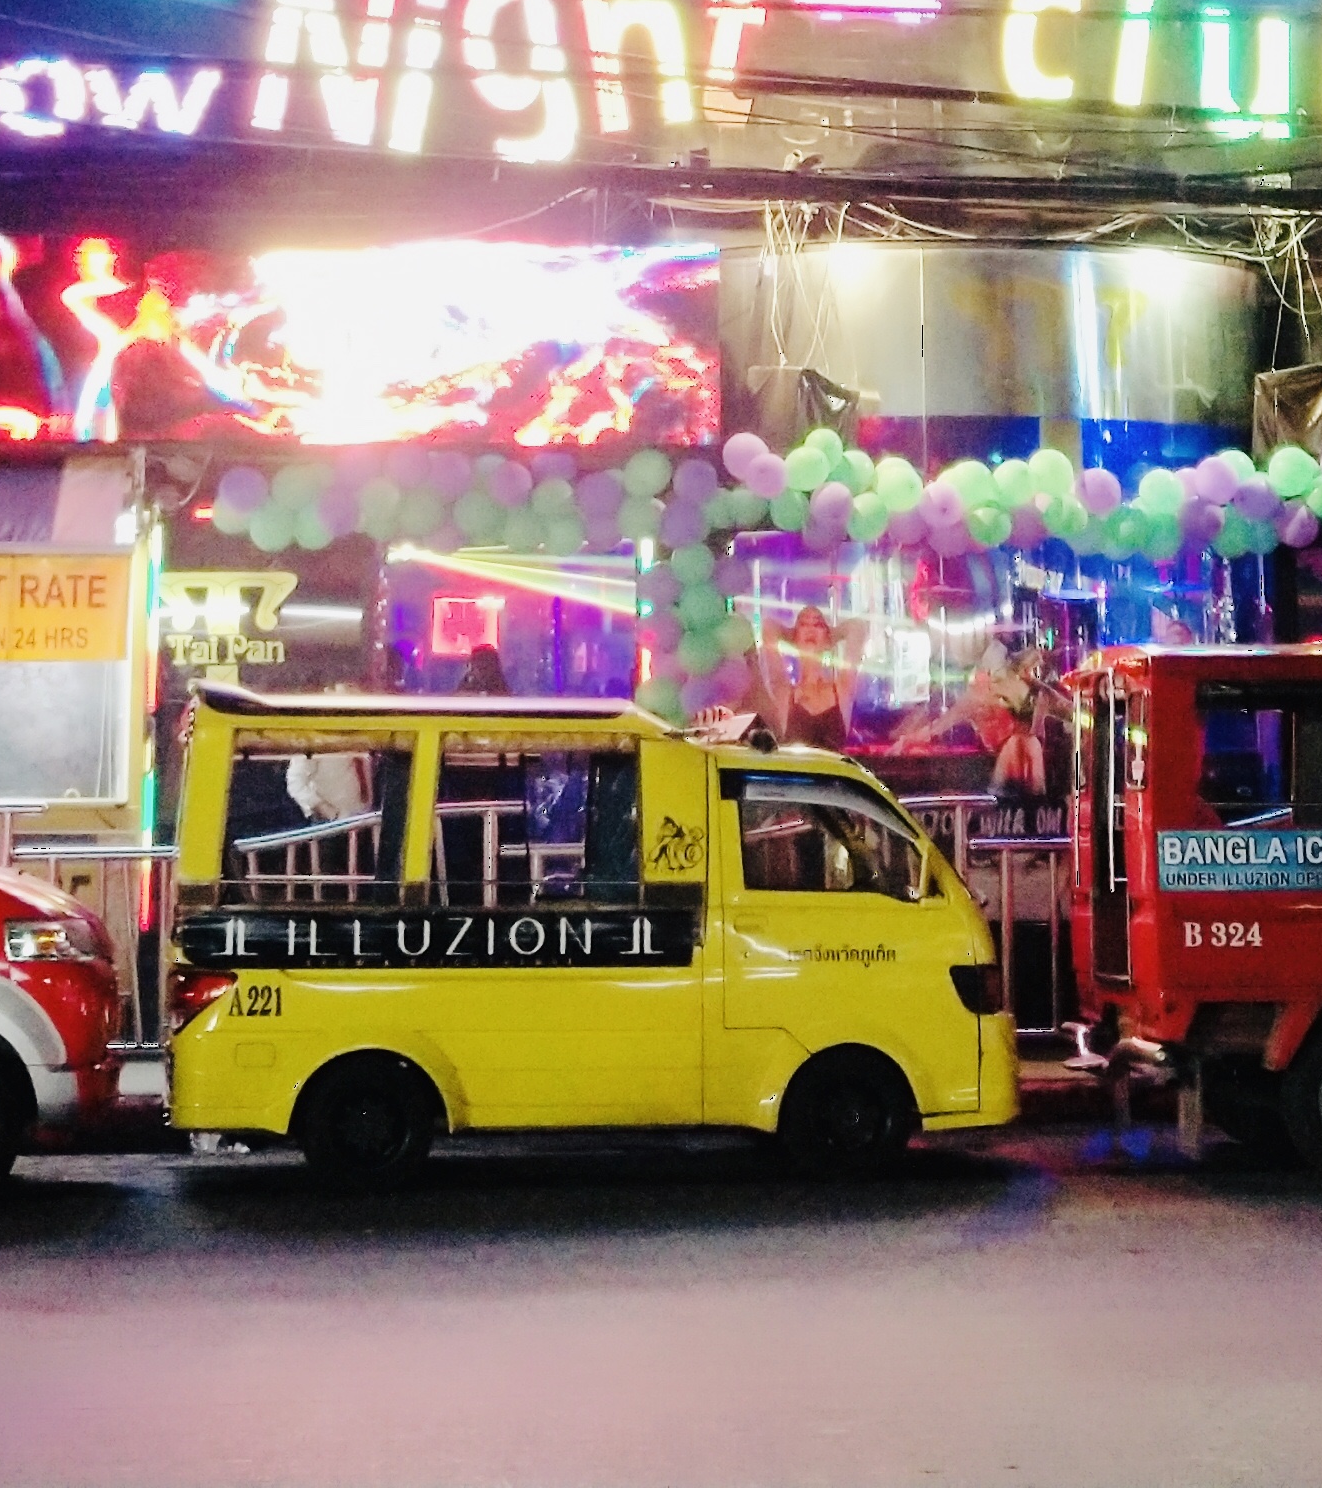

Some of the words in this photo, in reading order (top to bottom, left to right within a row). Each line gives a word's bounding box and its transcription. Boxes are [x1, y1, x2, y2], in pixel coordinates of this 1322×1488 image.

[19, 574, 107, 609] RATE
[15, 627, 36, 650] 24
[45, 627, 88, 650] HRS
[166, 634, 219, 665] Tai
[226, 634, 285, 665] Pan
[1163, 836, 1286, 865] BANGLA
[1166, 872, 1217, 886] UNDER
[1222, 871, 1290, 886] ILLUZION
[287, 916, 593, 956] ILLUZION
[1184, 922, 1202, 947] B
[1211, 922, 1263, 947] 324
